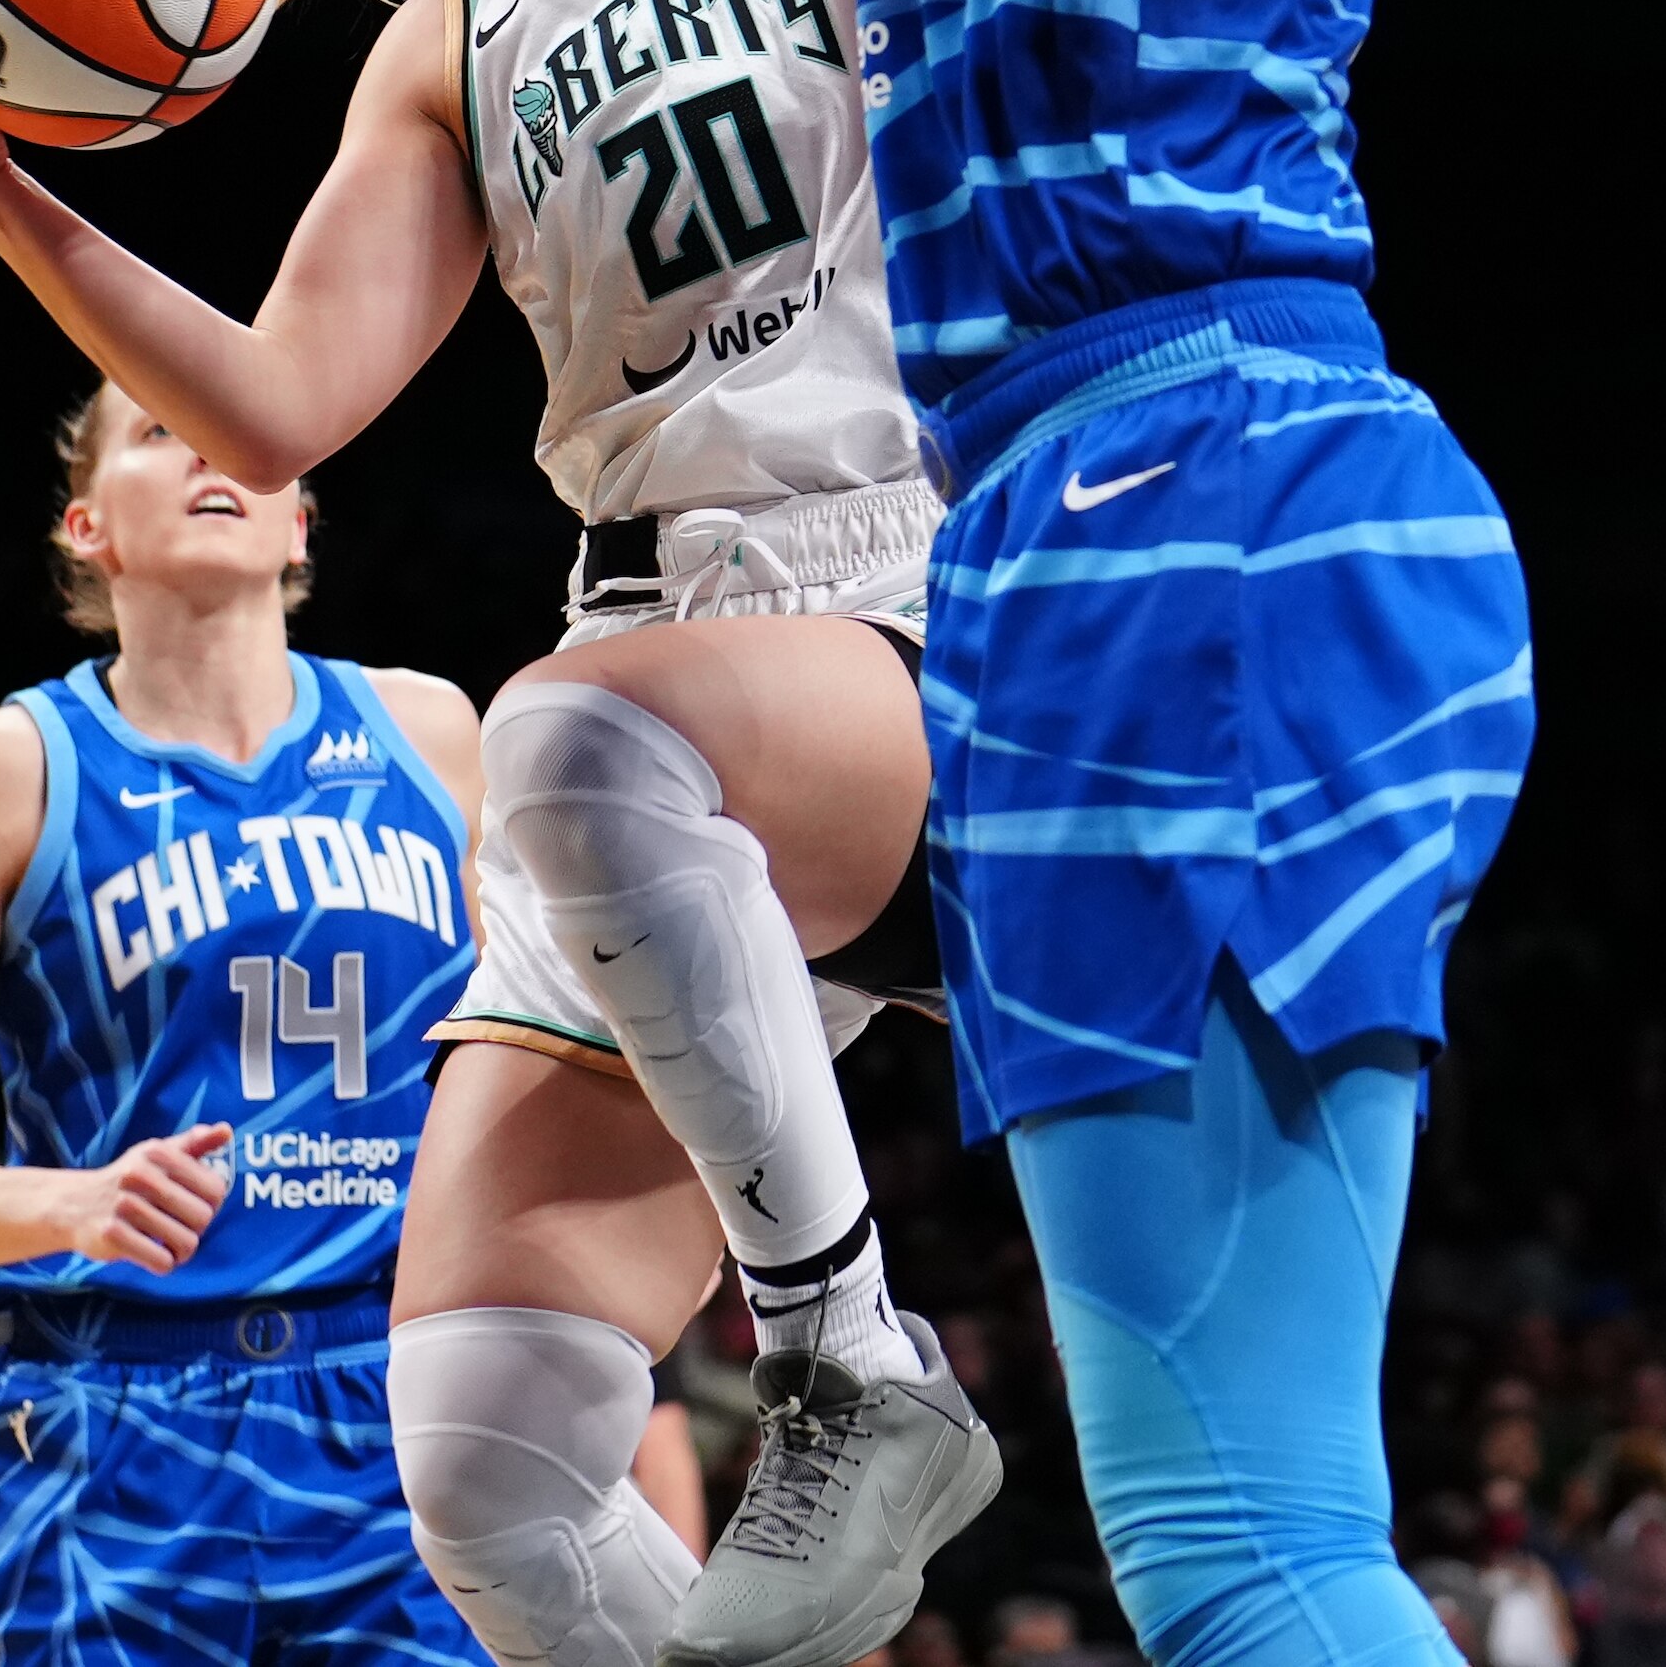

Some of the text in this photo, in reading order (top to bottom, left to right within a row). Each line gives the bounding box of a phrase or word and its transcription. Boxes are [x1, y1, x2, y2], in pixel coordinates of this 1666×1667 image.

[597, 75, 810, 303] 20
[230, 951, 368, 1100] 14
[244, 1131, 401, 1172] UChicago
